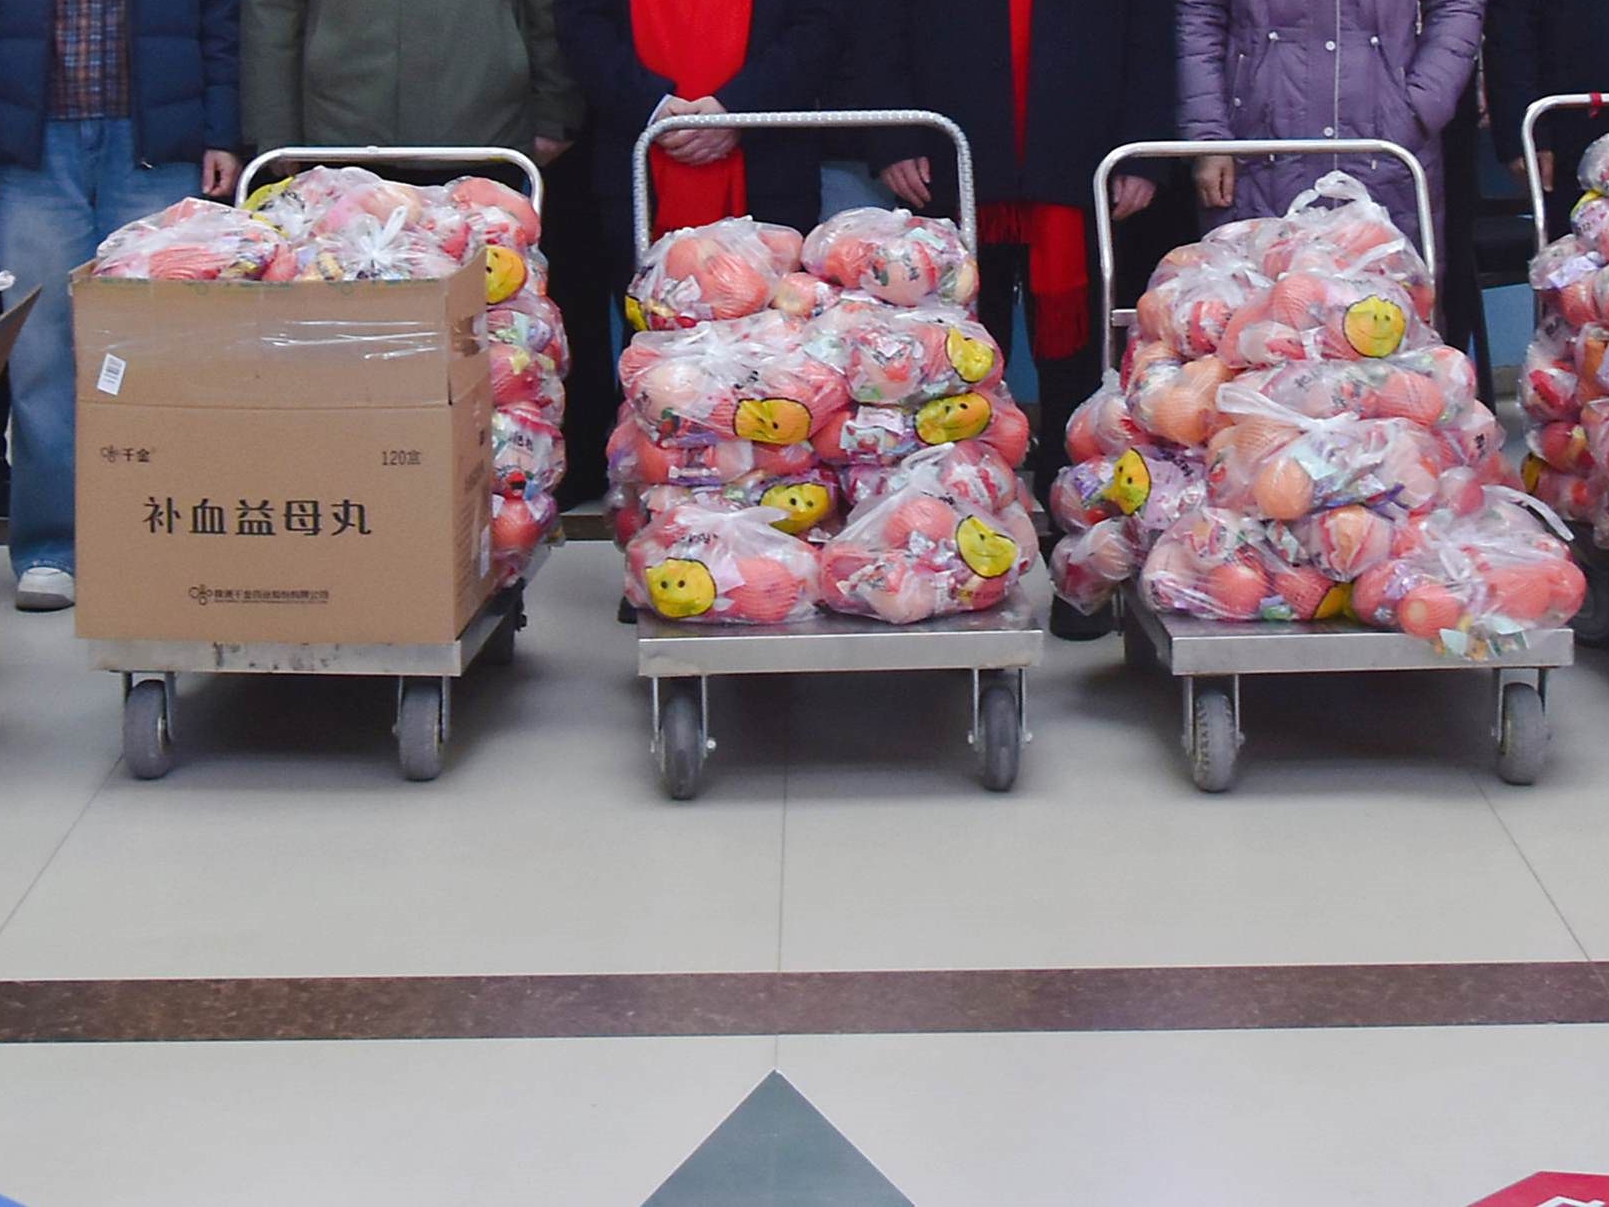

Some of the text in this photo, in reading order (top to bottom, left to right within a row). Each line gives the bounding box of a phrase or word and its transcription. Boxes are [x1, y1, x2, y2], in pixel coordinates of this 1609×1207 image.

[142, 496, 373, 537] 补血益母丸
